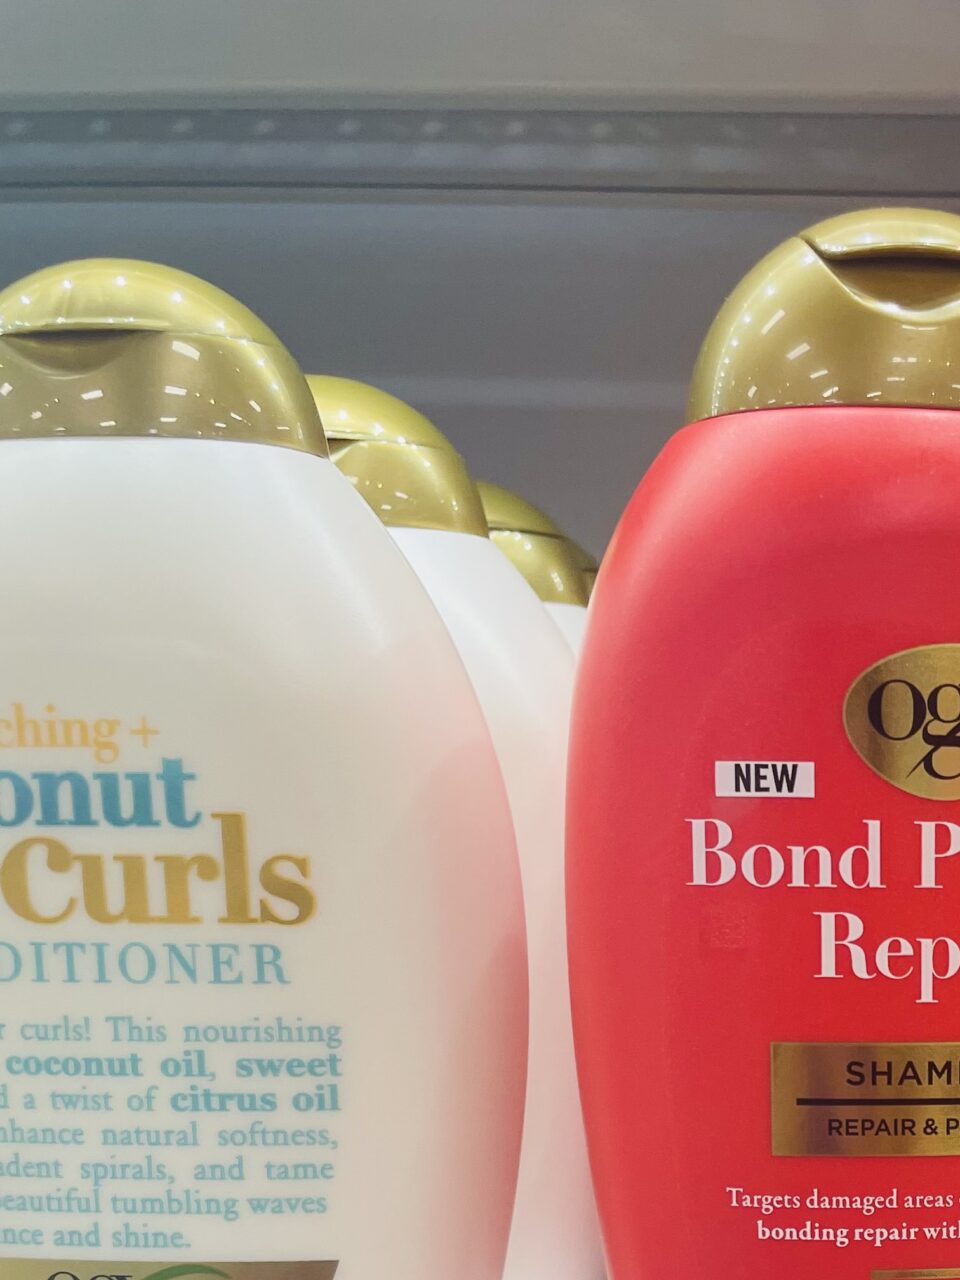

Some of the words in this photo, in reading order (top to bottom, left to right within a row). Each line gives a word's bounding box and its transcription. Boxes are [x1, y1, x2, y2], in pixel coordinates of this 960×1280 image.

[733, 764, 799, 793] NEW
[684, 818, 887, 888] Bond
[0, 811, 317, 926] Curls
[20, 1014, 92, 1042] curls!
[105, 1015, 168, 1042] This
[183, 1018, 342, 1048] nourishing
[6, 1053, 143, 1077] coconut
[160, 1050, 217, 1082] oil,
[235, 1055, 342, 1078] sweet
[49, 1085, 114, 1112] twist
[126, 1085, 159, 1111] of
[170, 1087, 278, 1112] citrus
[291, 1085, 341, 1112] oil
[101, 1121, 200, 1147] natural
[217, 1123, 339, 1151] softness,
[827, 1116, 917, 1138] REPAIR
[80, 1154, 175, 1188] spirals,
[193, 1158, 245, 1181] and
[264, 1160, 335, 1181] tame
[110, 1189, 239, 1220] tumbling
[247, 1197, 328, 1215] waves
[726, 1186, 800, 1213] Targets
[806, 1187, 898, 1216] damaged
[903, 1189, 953, 1210] areas
[53, 1222, 101, 1247] and
[111, 1223, 191, 1250] shine.
[757, 1220, 850, 1248] bonding
[854, 1222, 919, 1248] repair
